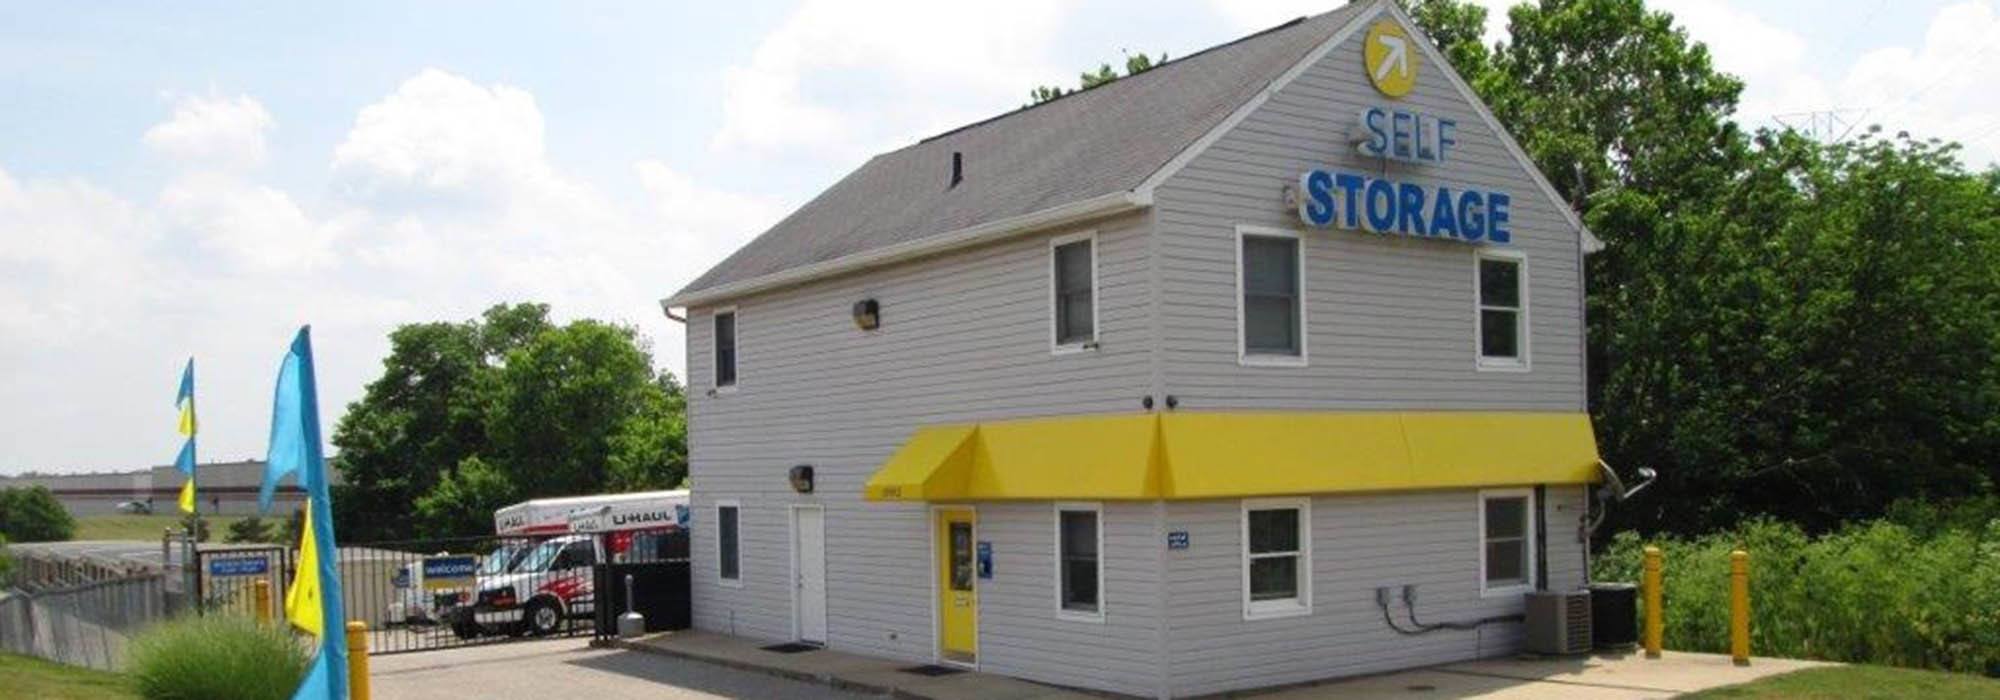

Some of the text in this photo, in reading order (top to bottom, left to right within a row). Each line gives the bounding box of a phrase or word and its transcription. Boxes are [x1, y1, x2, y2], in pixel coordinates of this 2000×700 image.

[1363, 106, 1456, 161] SELF
[1306, 168, 1511, 244] STORAGE
[612, 510, 672, 526] U-HAUL
[425, 563, 474, 575] welcome
